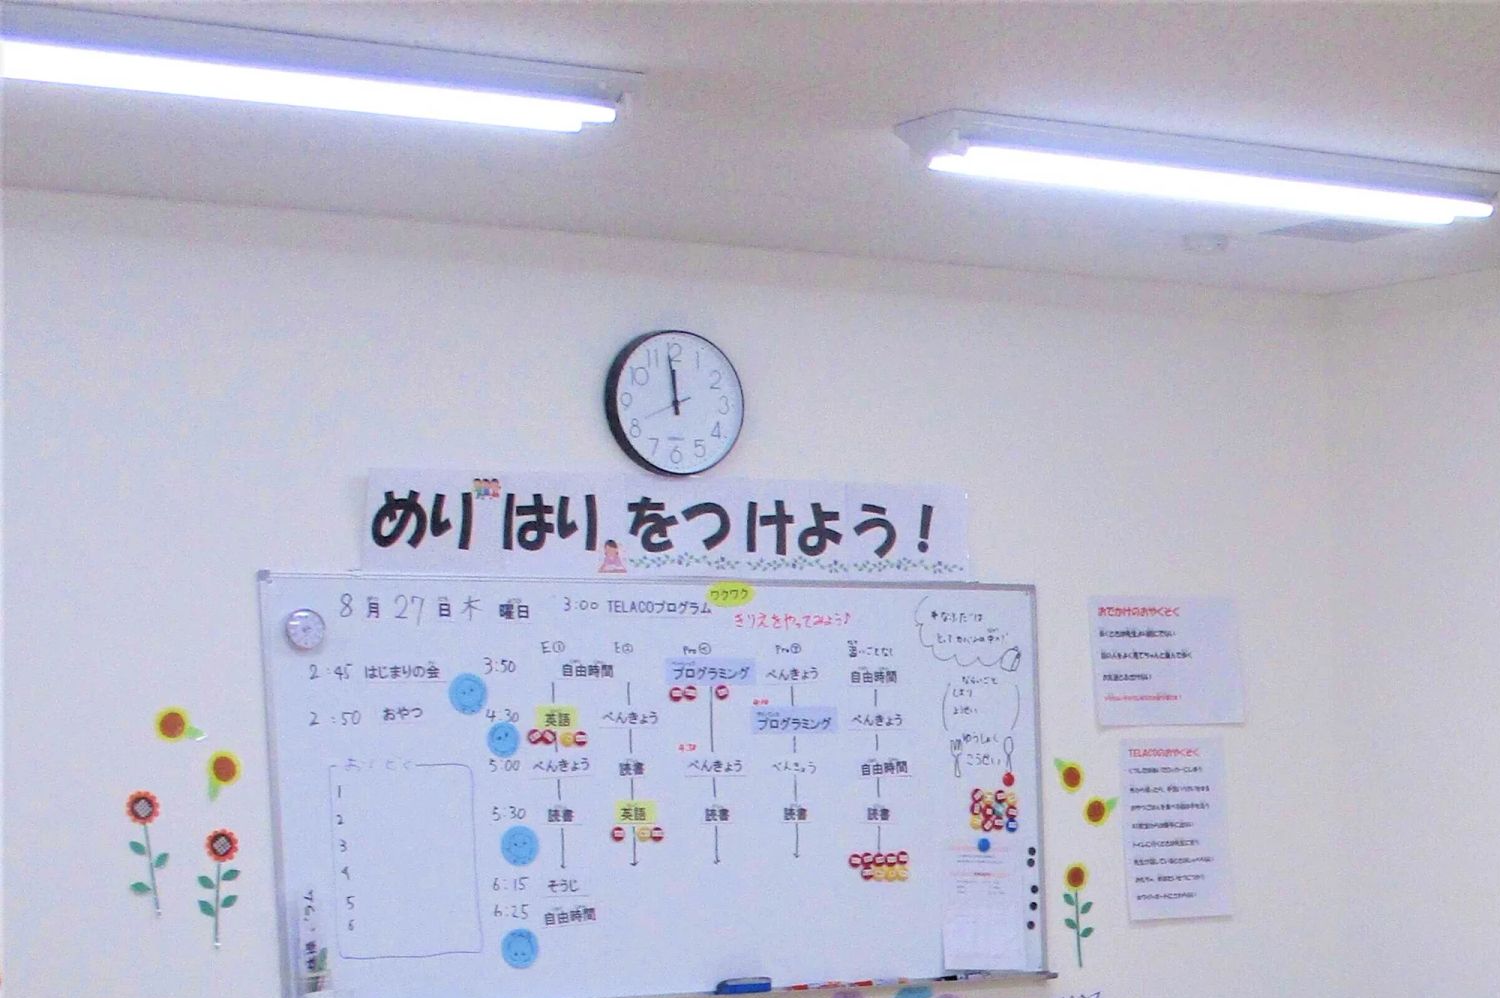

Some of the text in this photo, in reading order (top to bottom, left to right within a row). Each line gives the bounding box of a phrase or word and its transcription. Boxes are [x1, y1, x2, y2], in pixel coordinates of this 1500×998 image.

[646, 349, 658, 368] 11
[666, 342, 682, 362] 12
[695, 351, 700, 369] 1
[630, 366, 649, 386] 10
[709, 370, 721, 389] 2
[620, 392, 632, 409] 9
[718, 395, 730, 415] 3
[629, 418, 641, 438] 8
[711, 421, 721, 439] 4
[648, 437, 659, 456] 7
[694, 439, 705, 458] 5
[670, 445, 682, 464] 6
[710, 589, 749, 601] ワクワク
[339, 593, 529, 626] 8 月 27 日 木 曜日
[309, 664, 440, 680] 2:45 はじまりの会
[483, 657, 516, 674] 3:50
[561, 664, 614, 678] 自由時間
[673, 666, 749, 680] プログラミング
[765, 667, 818, 680] べんきょう
[851, 671, 898, 684] 自由時間
[309, 707, 423, 726] 2:50 おやつ
[545, 713, 571, 727] 英語
[602, 711, 659, 724] べんきょう
[758, 716, 831, 731] プログラミング
[852, 714, 903, 727] べんきょう
[489, 760, 521, 772] 5:00
[532, 758, 590, 772] べんきょう
[619, 762, 645, 776] 読書
[688, 759, 743, 773] べんきょう
[861, 761, 908, 776] 自由時間
[336, 814, 344, 825] 2
[492, 806, 526, 821] 5:30
[547, 809, 574, 823] 読書
[621, 806, 646, 821] 英語
[704, 808, 730, 822] 読書
[783, 807, 807, 821] 読書
[866, 807, 890, 821] 読書
[340, 839, 347, 852] 3
[492, 877, 529, 891] 6:15
[547, 879, 580, 893] そうじ
[346, 896, 355, 910] 5
[494, 904, 529, 919] 6:25
[544, 908, 597, 926] 自由時間
